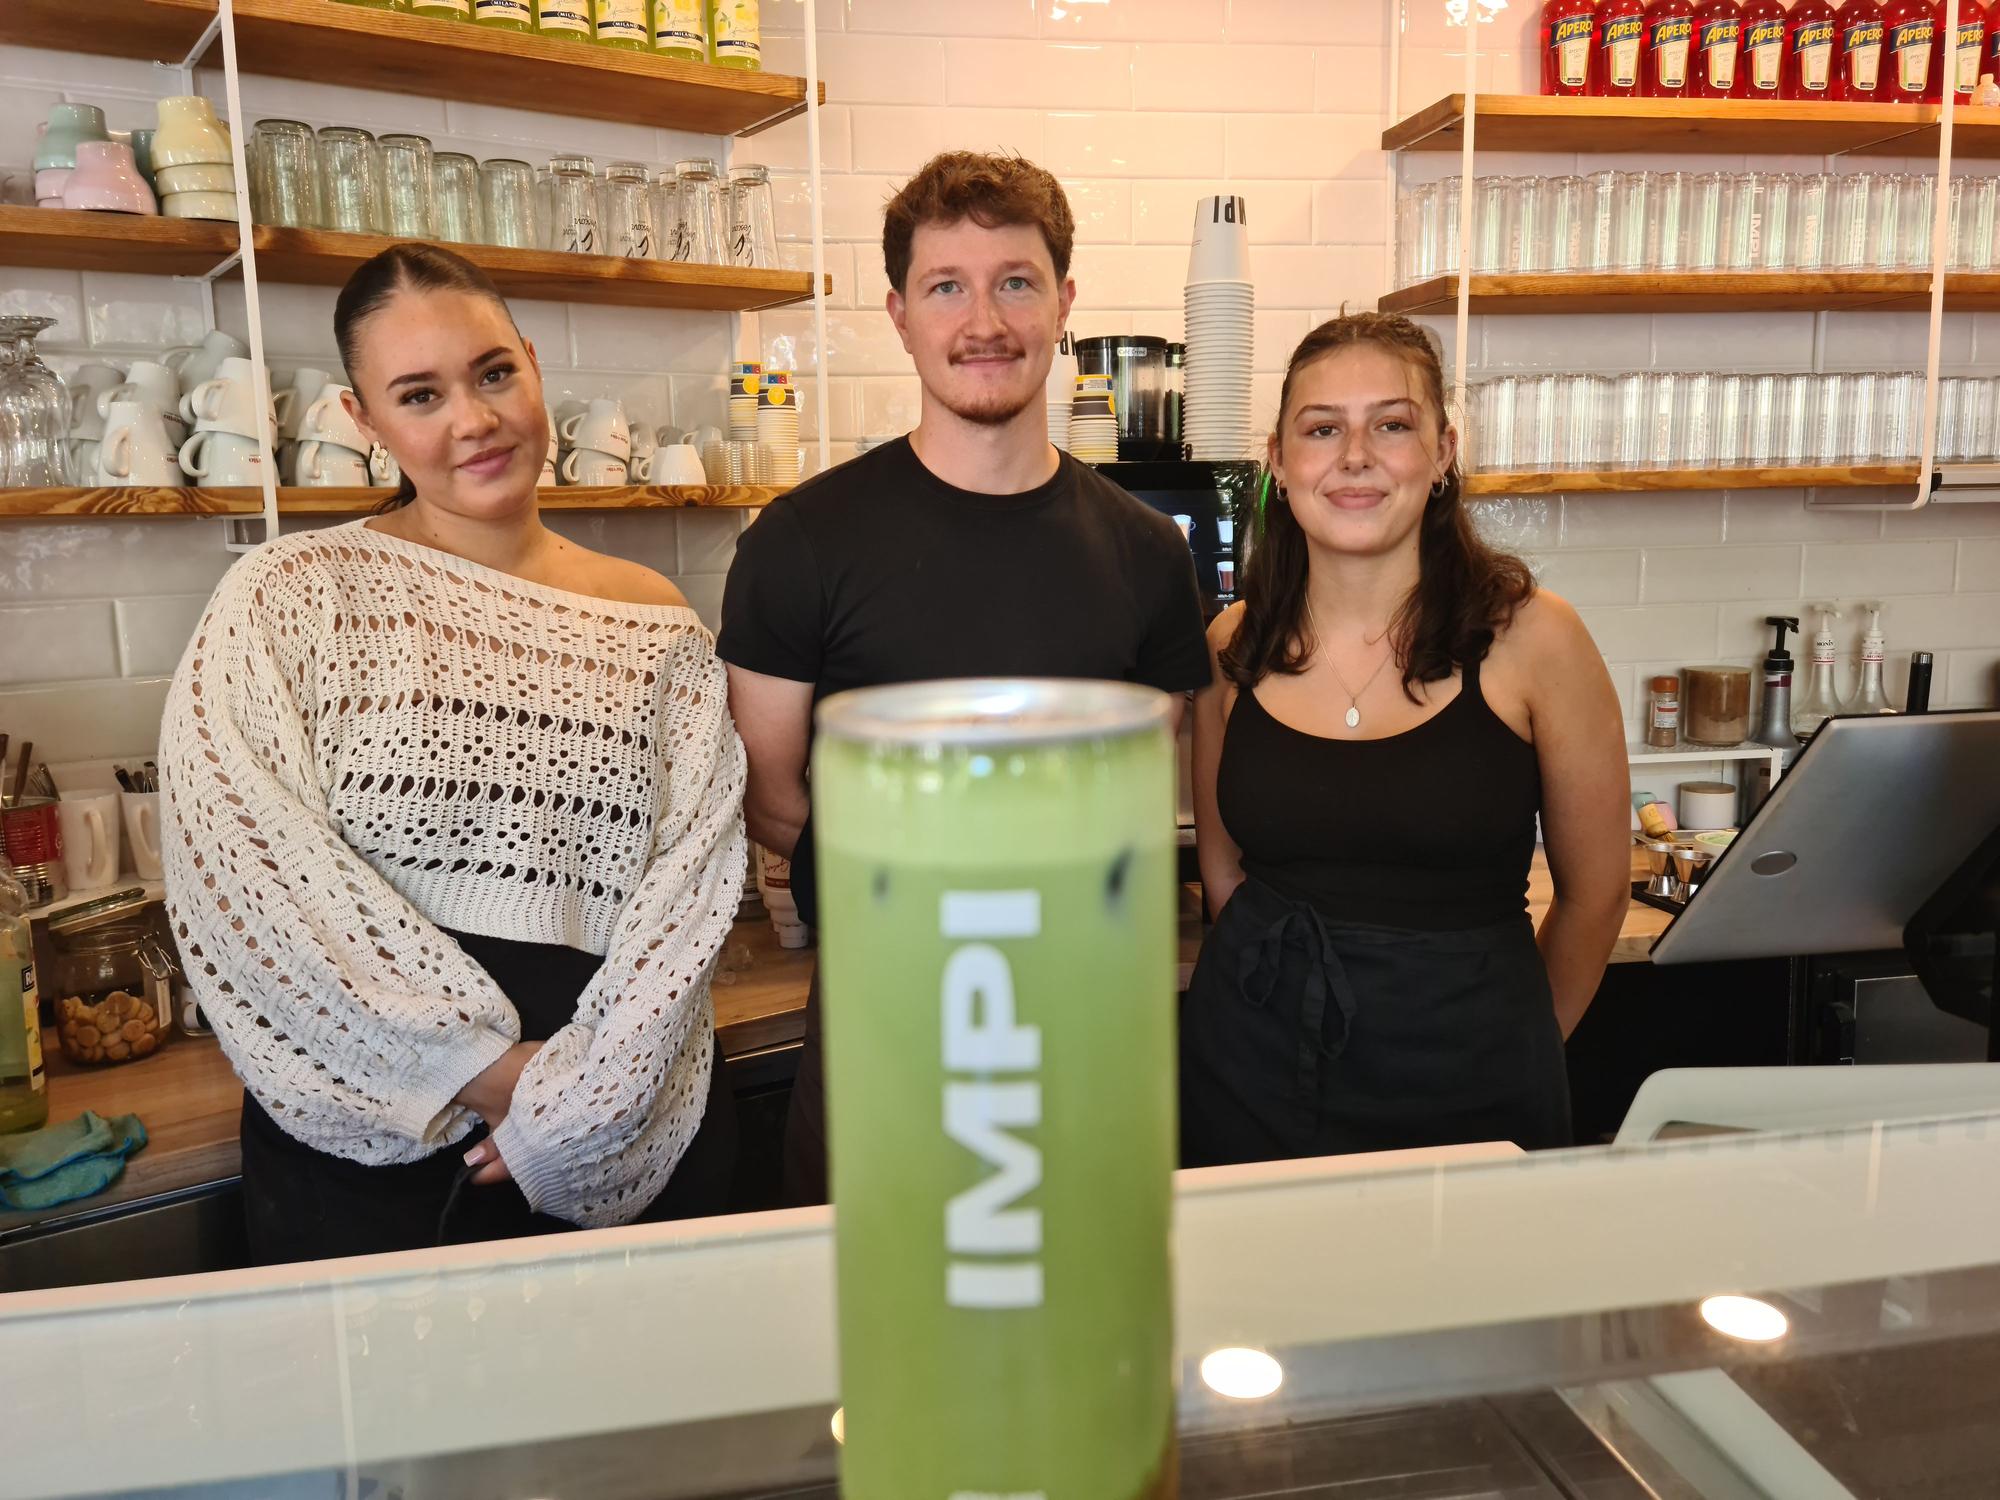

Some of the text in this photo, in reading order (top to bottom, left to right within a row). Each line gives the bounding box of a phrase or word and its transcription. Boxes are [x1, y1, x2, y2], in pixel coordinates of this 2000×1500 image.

[493, 0, 518, 8] MILANO
[560, 12, 583, 20] MILANO
[615, 21, 638, 29] MILANO
[674, 31, 696, 39] MILANO
[1749, 26, 1785, 46] APERO
[1798, 27, 1834, 47] APERO
[1895, 27, 1933, 46] APERO
[734, 40, 755, 48] MILANO
[939, 889, 1045, 1310] IMPI
